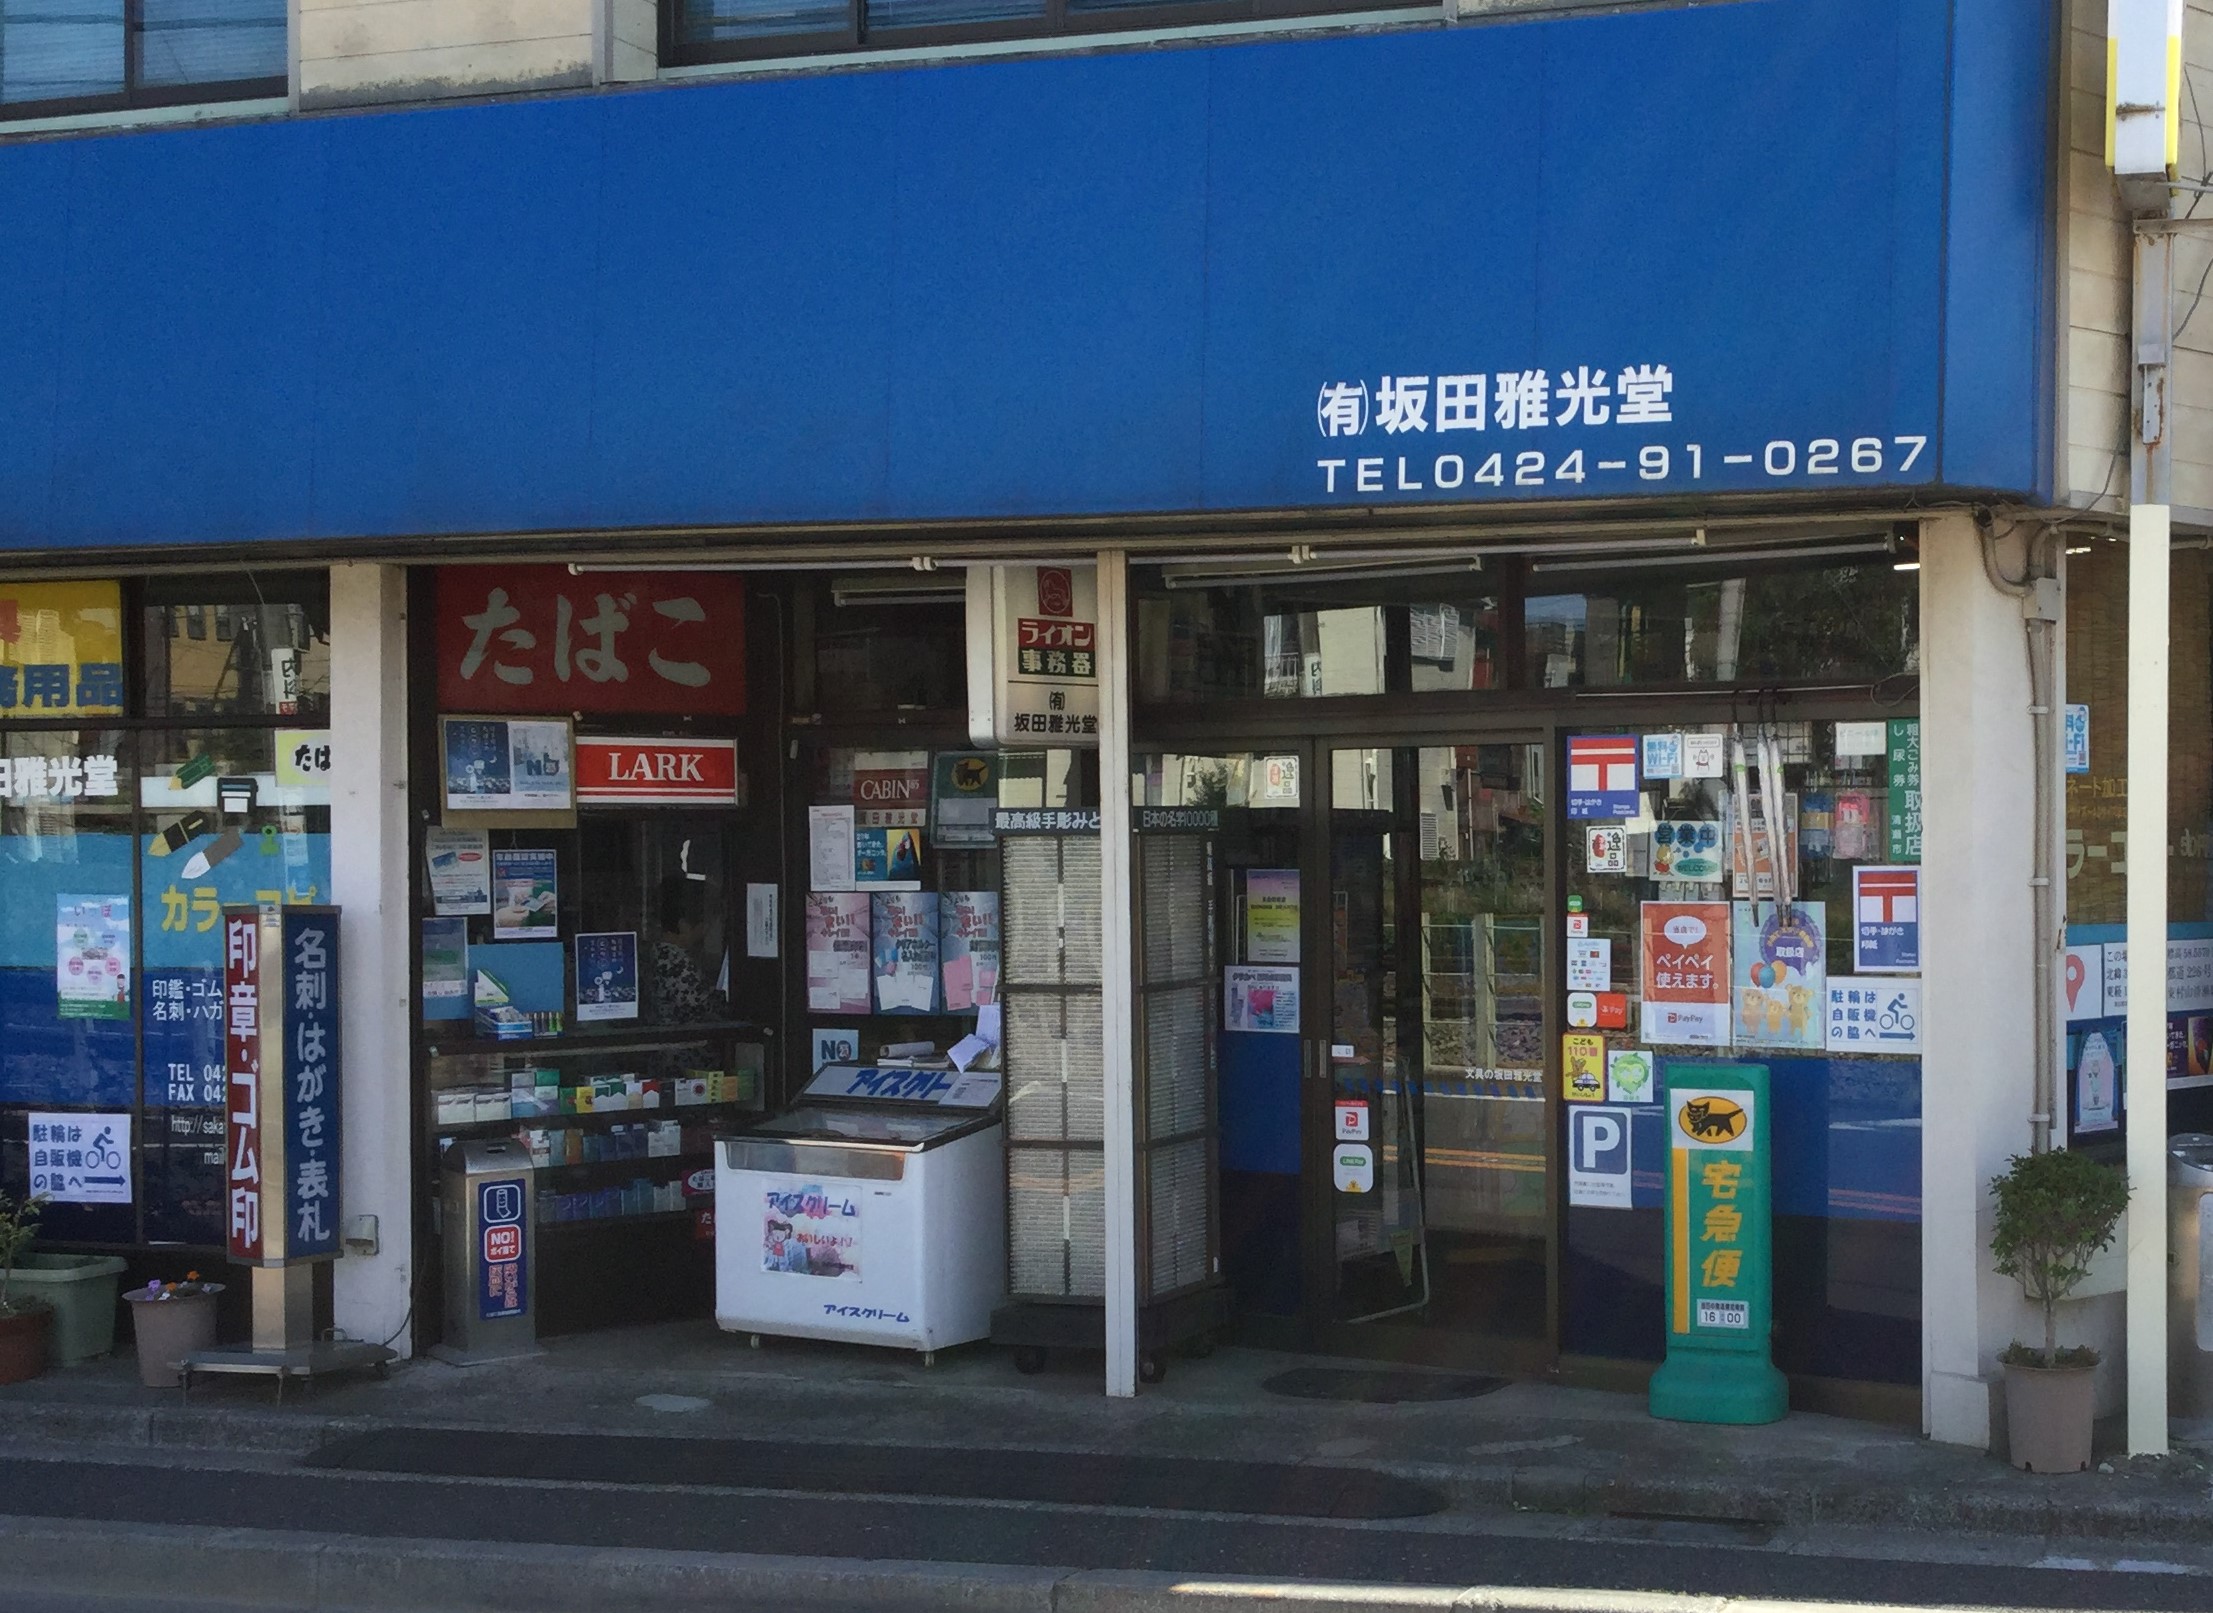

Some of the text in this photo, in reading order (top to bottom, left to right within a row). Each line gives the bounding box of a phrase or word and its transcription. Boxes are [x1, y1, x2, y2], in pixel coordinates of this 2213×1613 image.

[460, 587, 711, 688] たばこ
[1021, 621, 1091, 648] ライオン
[1021, 649, 1092, 675] 事務器
[1014, 713, 1098, 734] 坂田雅光堂
[608, 752, 705, 782] LARK
[860, 779, 910, 800] CABIN
[1656, 954, 1713, 970] ペイペイ
[1656, 971, 1719, 989] 使えます。
[1831, 990, 1876, 1004] 駐輪は
[1831, 1008, 1877, 1022] 自販機
[1573, 1037, 1594, 1045] こども
[1831, 1026, 1877, 1039] の脇へ
[168, 1063, 195, 1082] TEL
[168, 1083, 195, 1101] FAX
[228, 919, 259, 1249] 印章・ゴム印
[295, 928, 331, 1243] 名刺・はがき・表札
[33, 1124, 82, 1143] 駐輪は
[1583, 1116, 1621, 1169] P
[34, 1149, 82, 1167] 自販機
[34, 1173, 82, 1191] の脇へ
[767, 1191, 856, 1217] アイスクリーム
[1700, 1160, 1743, 1288] 宅急便
[490, 1230, 515, 1246] NO!
[824, 1304, 911, 1324] アイスクリーム
[1704, 1311, 1741, 1324] 16 00
